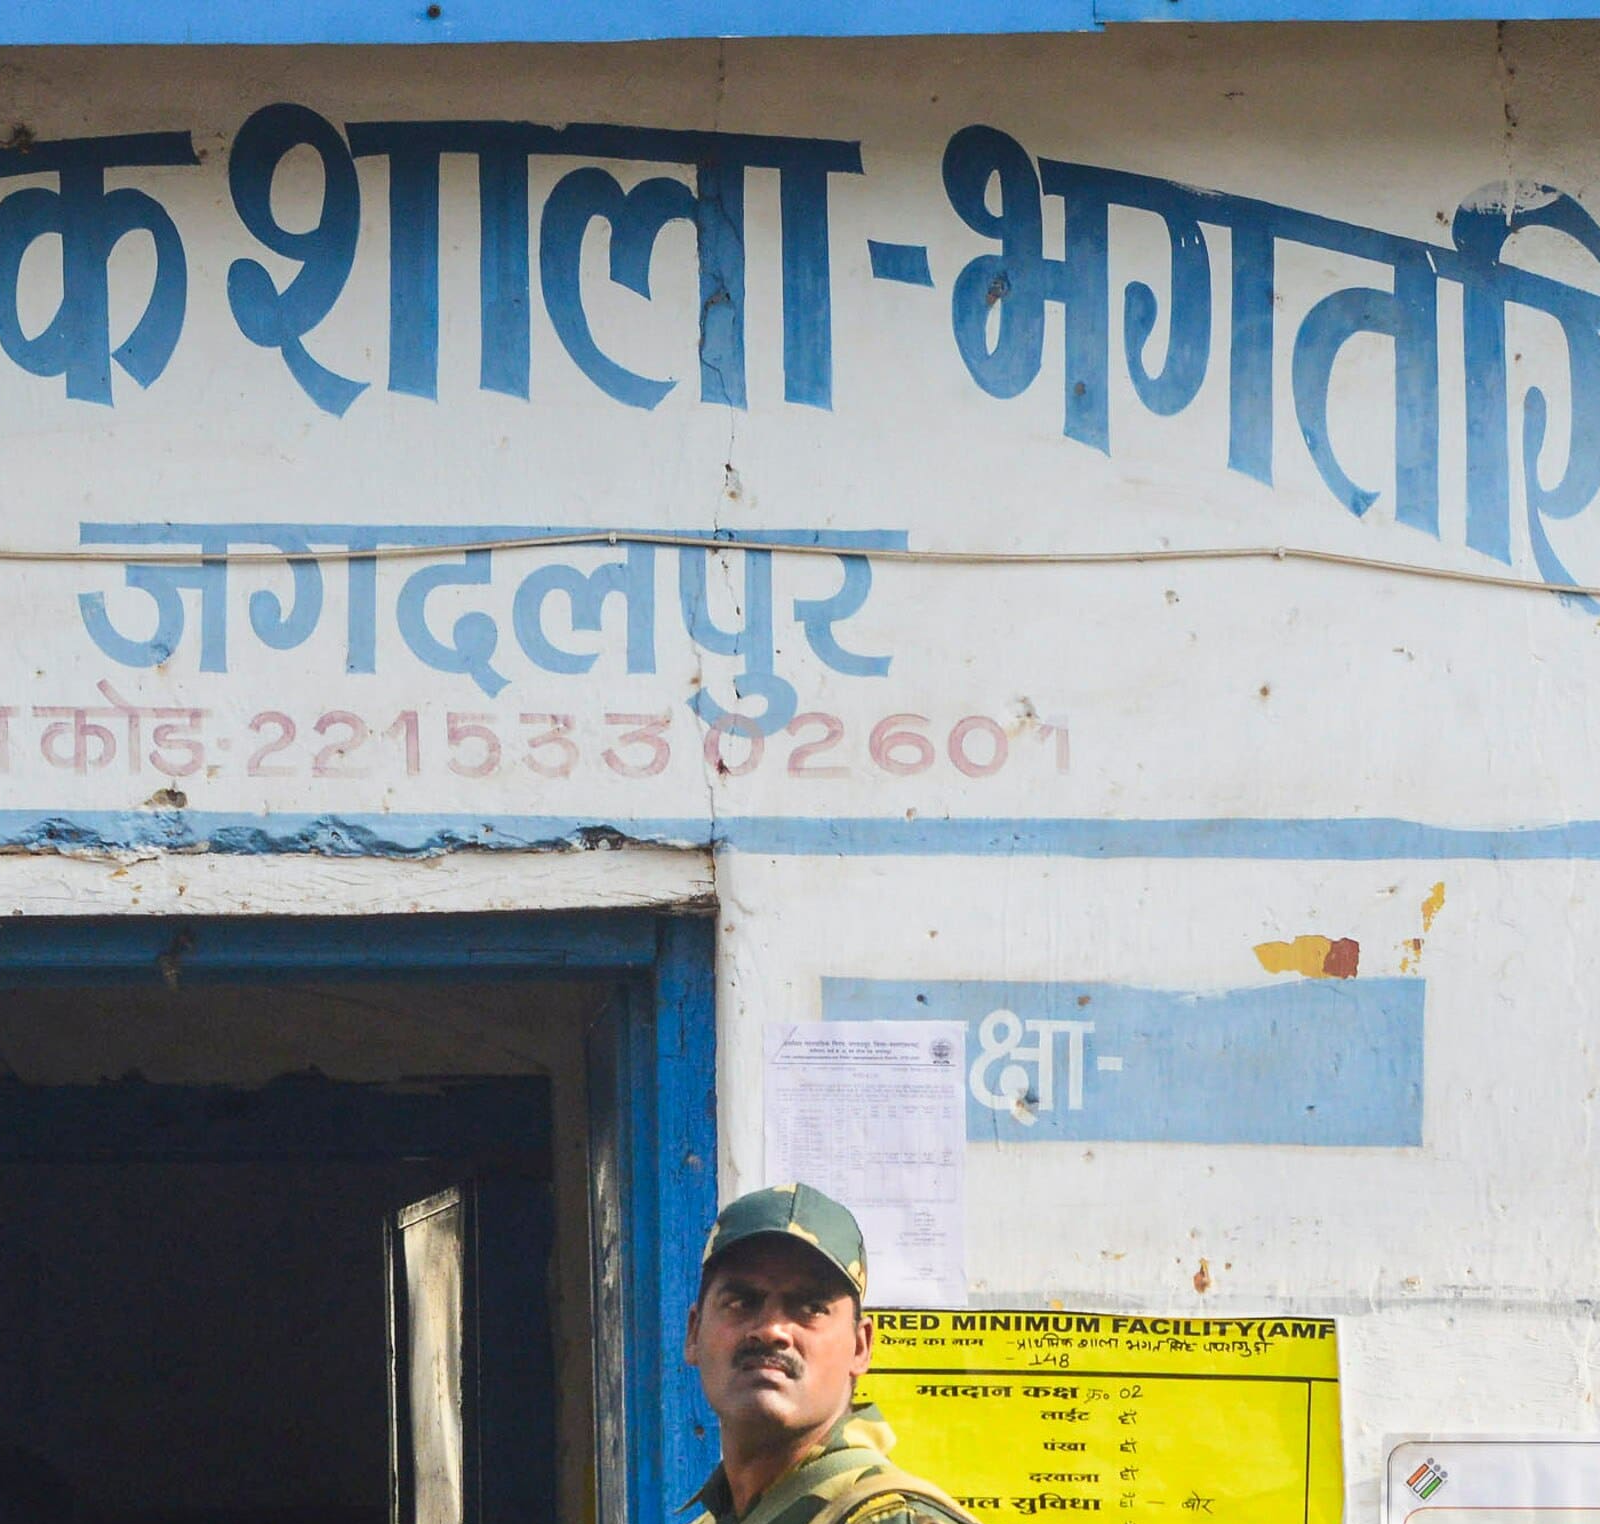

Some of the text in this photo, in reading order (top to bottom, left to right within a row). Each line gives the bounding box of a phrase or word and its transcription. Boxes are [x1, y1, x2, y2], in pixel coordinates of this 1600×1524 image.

[79, 522, 910, 738] जगदलपुर
[963, 1008, 1123, 1126] क्षा-
[870, 1314, 940, 1331] RED
[951, 1316, 1100, 1333] MINIMUM
[923, 1336, 945, 1346] का
[952, 1337, 984, 1347] नाम
[916, 1384, 1013, 1398] मतदान
[1022, 1384, 1080, 1400] कक्ष
[1040, 1407, 1090, 1422] लाईट
[1043, 1437, 1087, 1452] पंखा
[1028, 1472, 1100, 1483] दरवाजा
[1011, 1492, 1102, 1515] सुविधा
